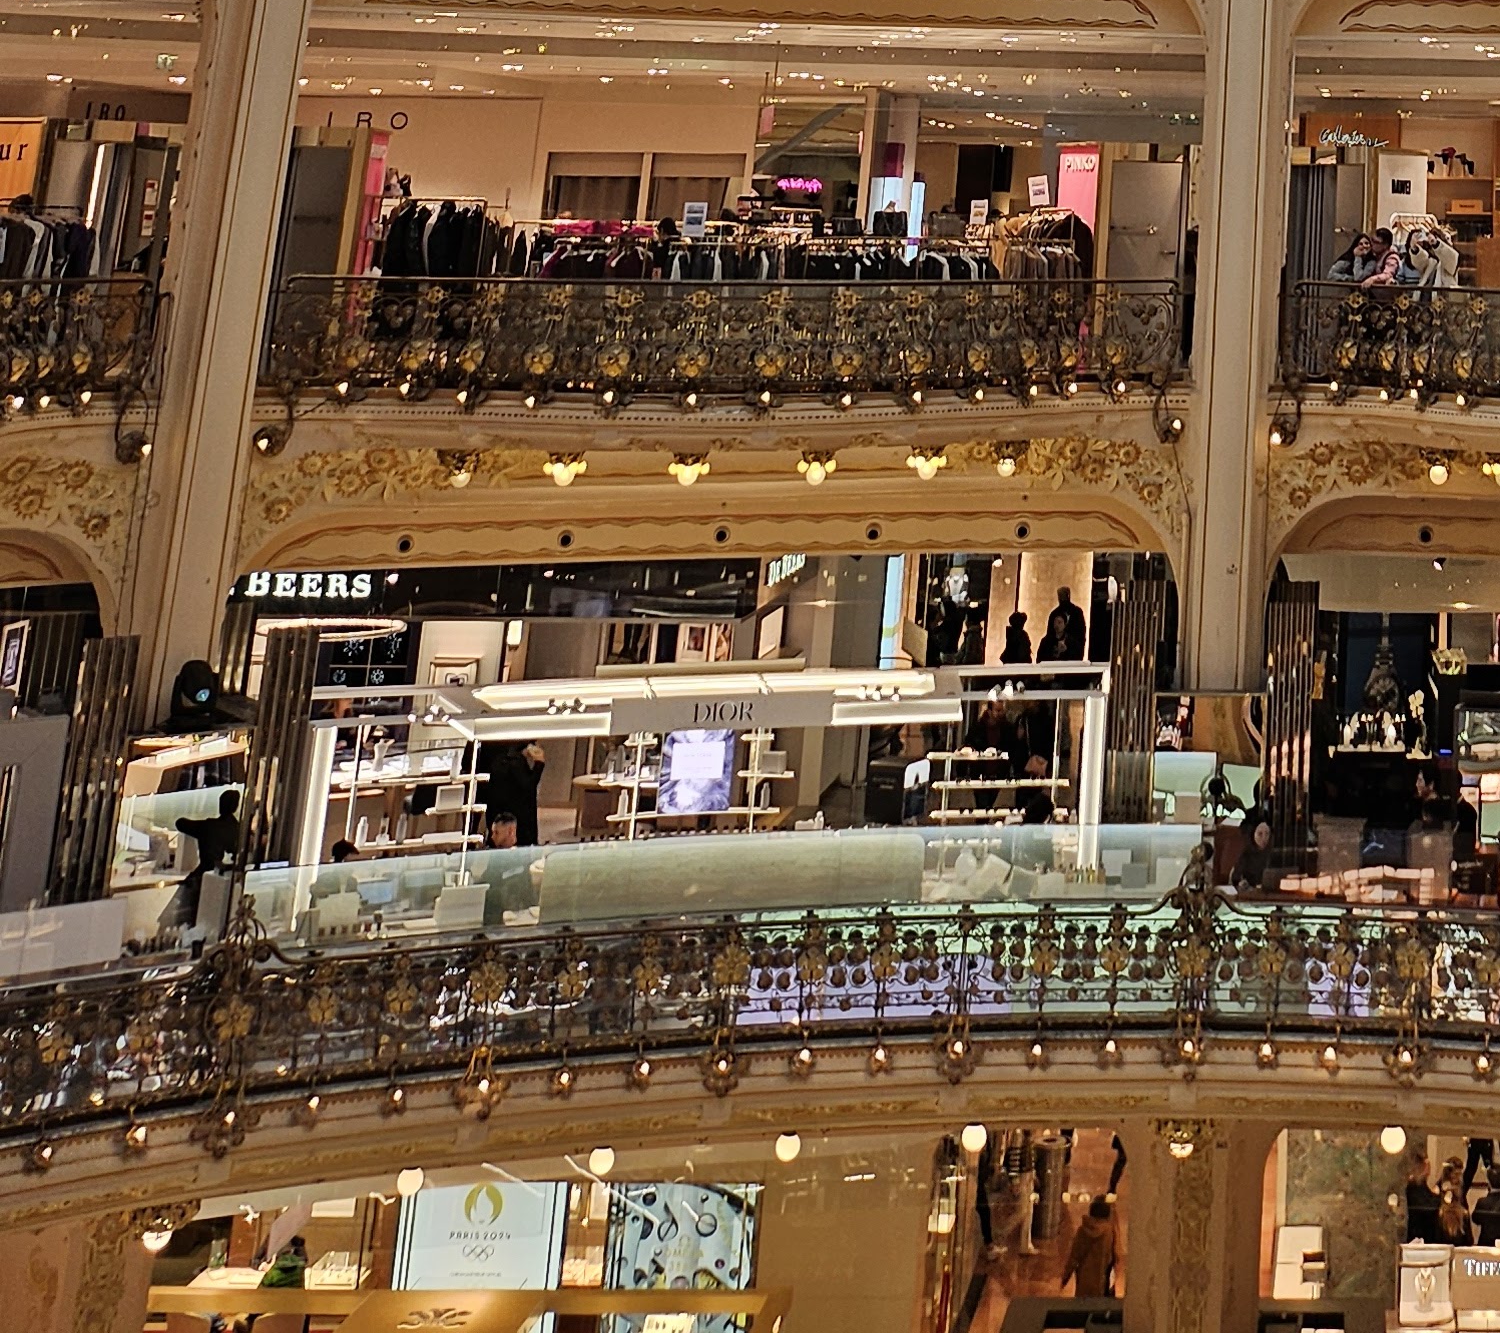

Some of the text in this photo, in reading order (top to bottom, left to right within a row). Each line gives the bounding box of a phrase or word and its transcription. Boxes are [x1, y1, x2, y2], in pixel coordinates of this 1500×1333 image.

[327, 111, 408, 130] IRO
[1065, 155, 1096, 172] PINKO
[244, 571, 372, 599] BEERS
[693, 700, 755, 723] DIOR
[449, 1231, 512, 1241] PARIS 2024
